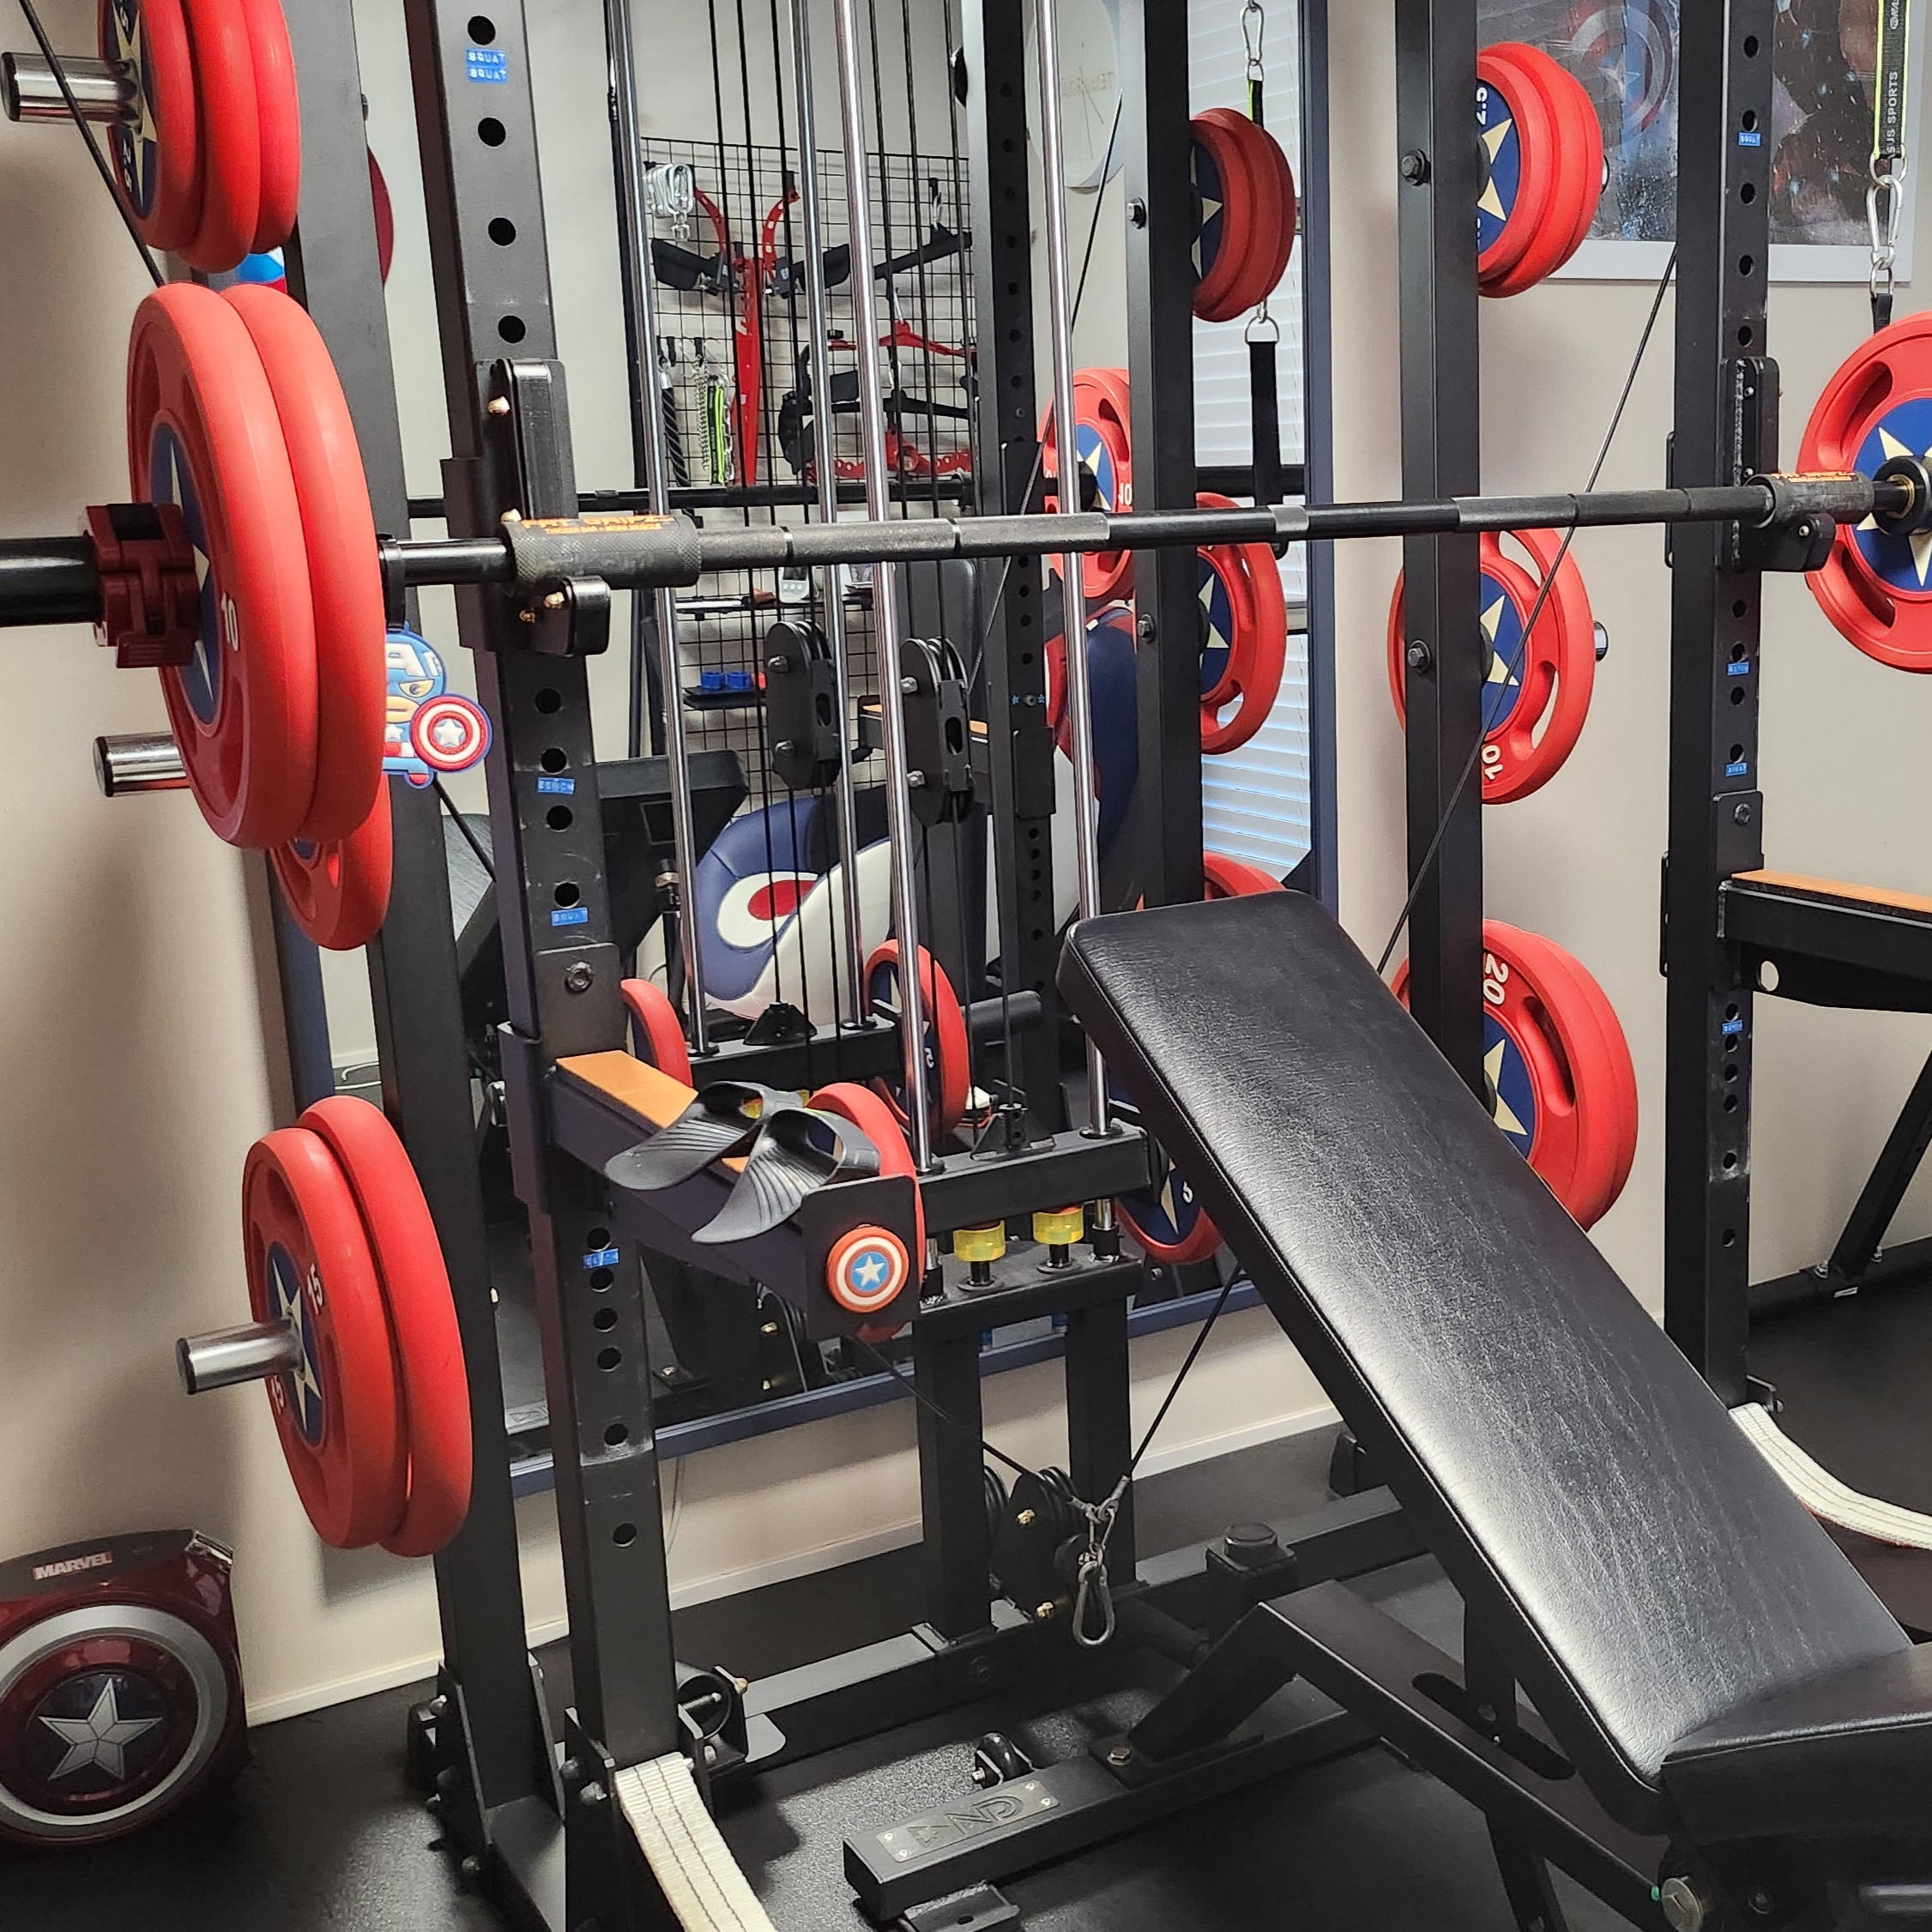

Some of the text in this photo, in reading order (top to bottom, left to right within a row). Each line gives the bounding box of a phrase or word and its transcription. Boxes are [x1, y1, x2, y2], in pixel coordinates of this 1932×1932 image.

[468, 52, 506, 63] SQUAT
[469, 68, 507, 80] SQUAT
[1887, 71, 1899, 124] SPORTS
[221, 591, 238, 651] 10
[1482, 745, 1503, 780] 10
[1483, 953, 1508, 1005] 20
[306, 1262, 324, 1315] 15
[35, 1551, 113, 1579] MARVEL
